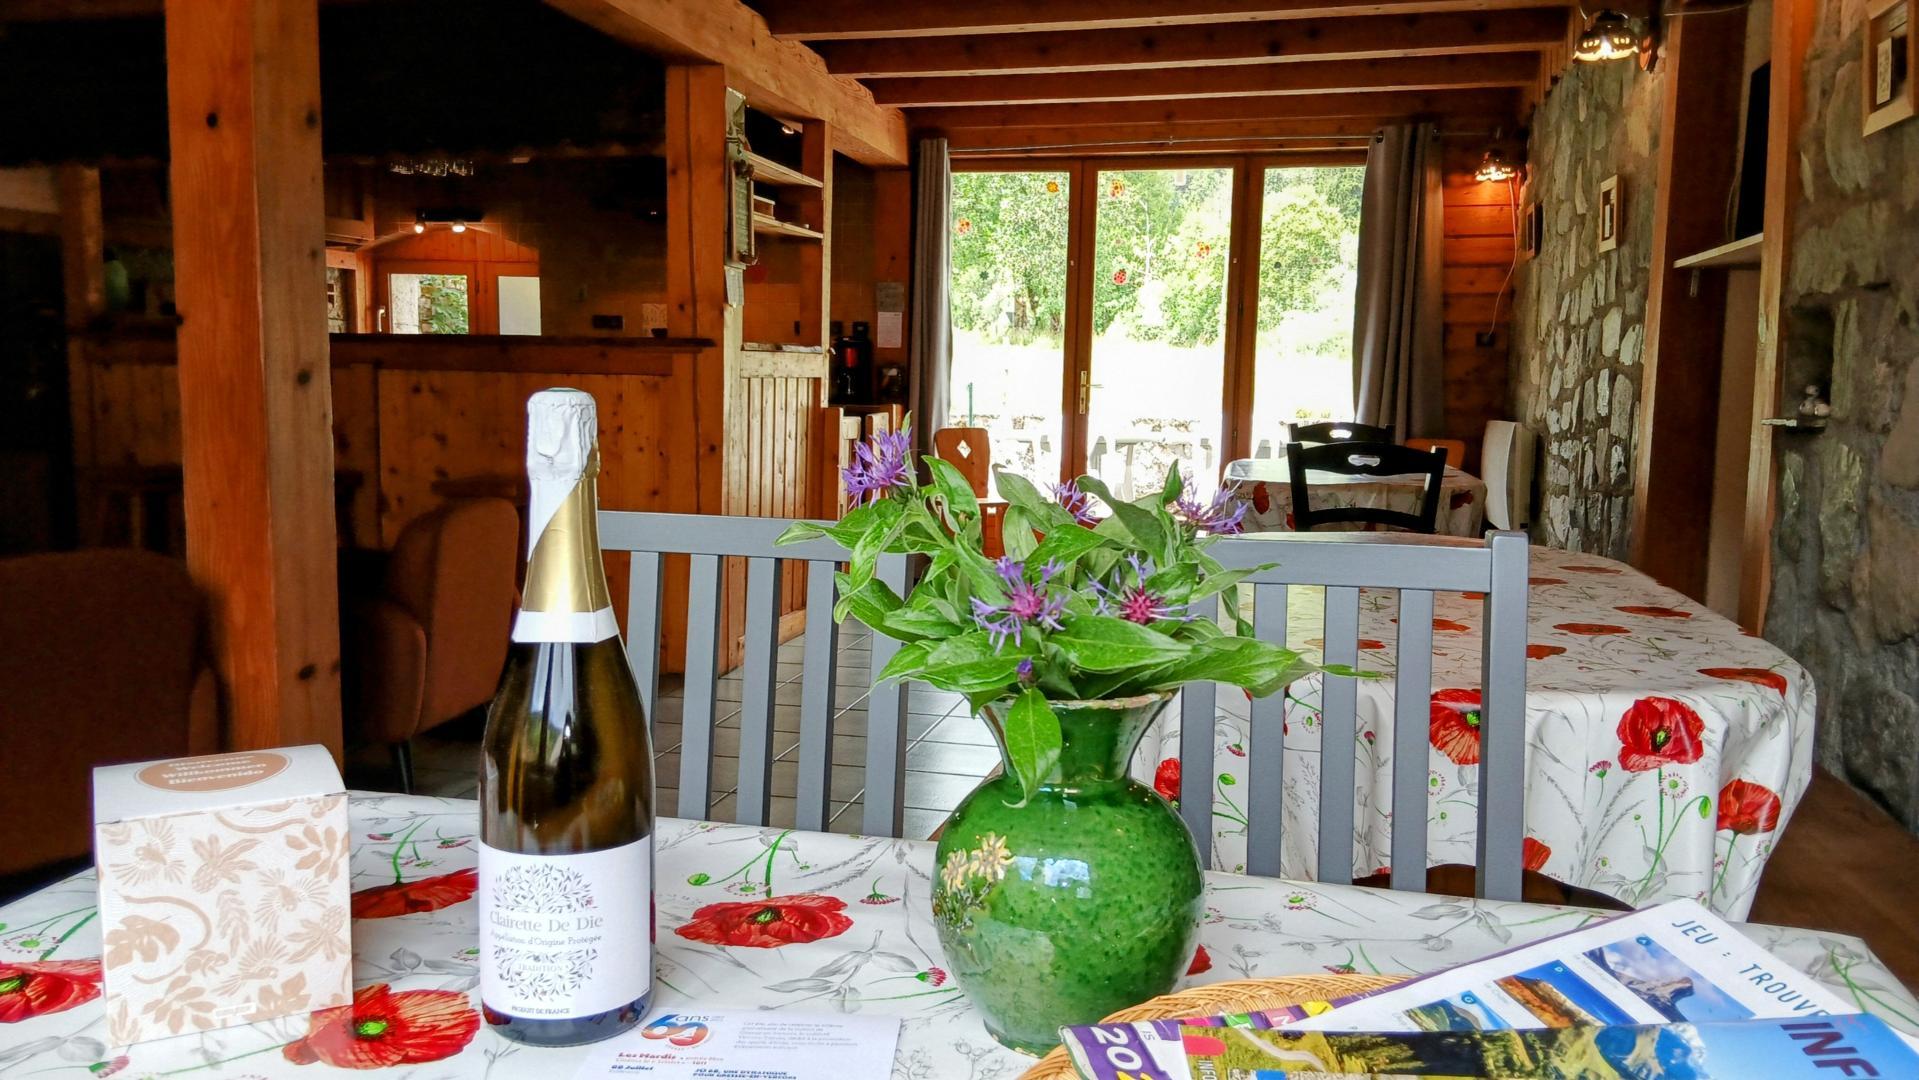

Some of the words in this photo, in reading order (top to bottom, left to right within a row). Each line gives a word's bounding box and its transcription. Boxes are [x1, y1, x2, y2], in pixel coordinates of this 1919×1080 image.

[168, 769, 265, 785] Bienvenido
[489, 911, 542, 931] Clairette
[548, 919, 570, 932] De
[576, 916, 604, 930] Die
[1671, 919, 1719, 945] JEU
[1780, 1022, 1881, 1080] INF
